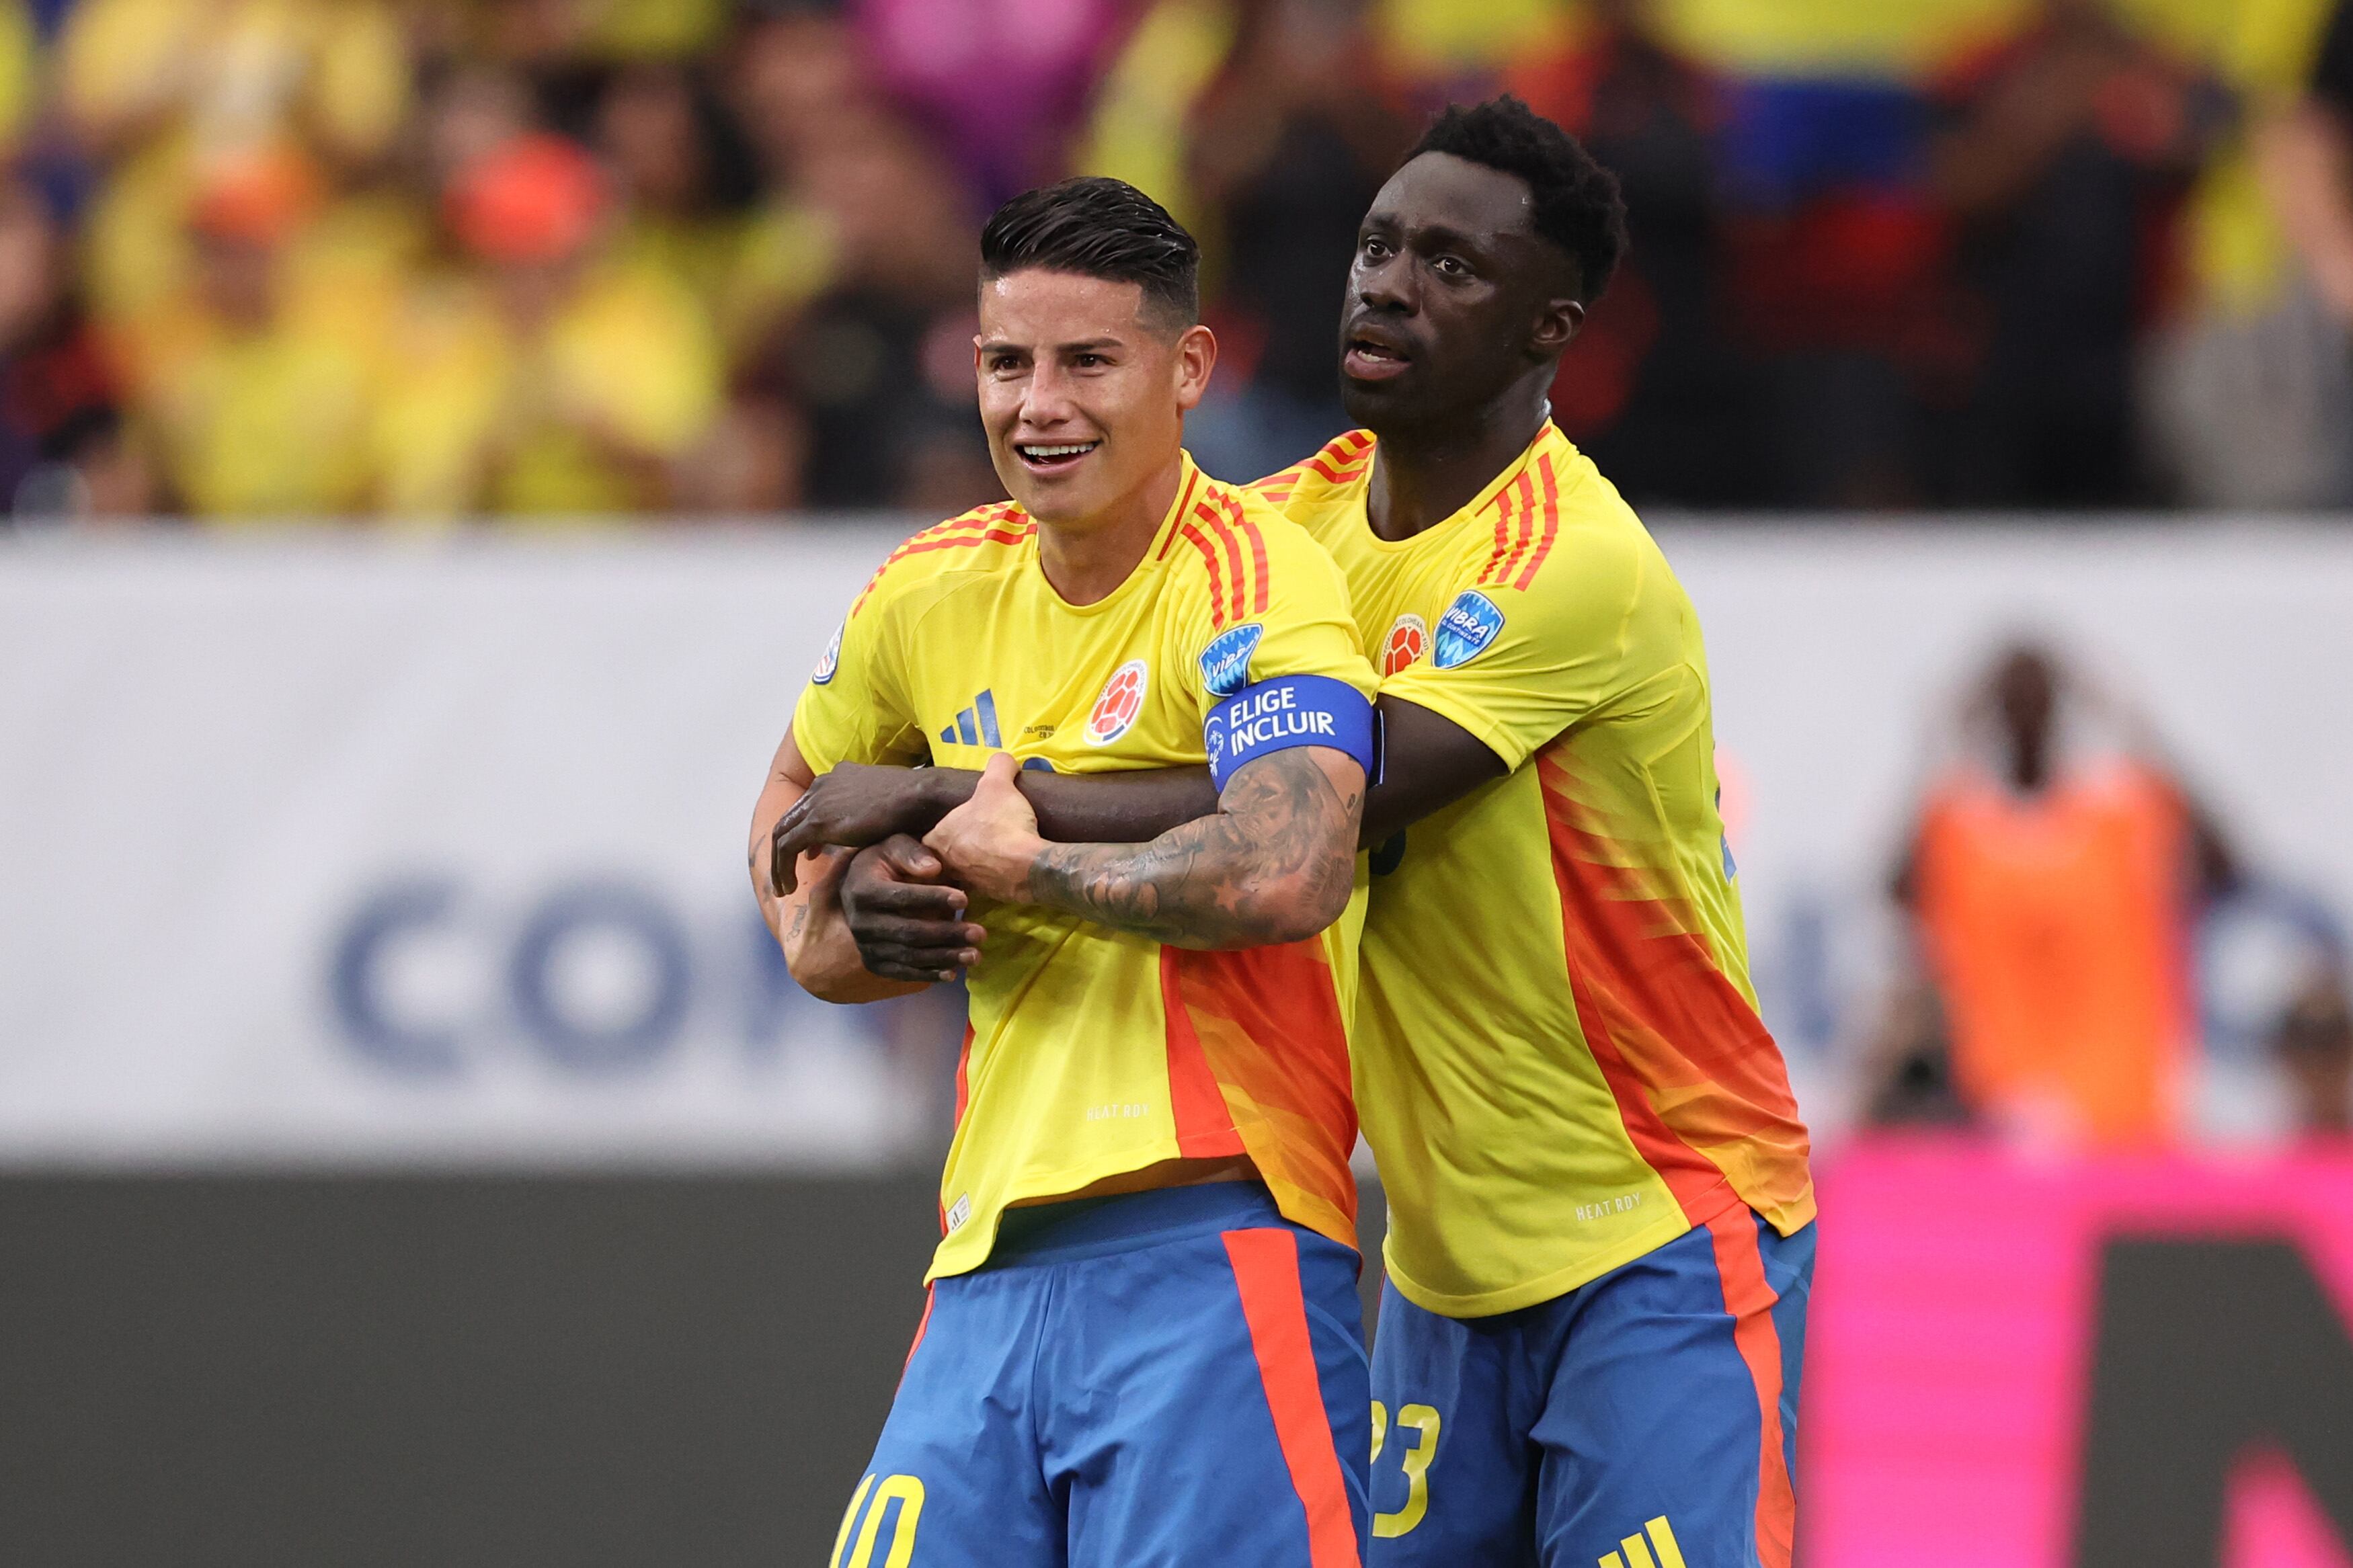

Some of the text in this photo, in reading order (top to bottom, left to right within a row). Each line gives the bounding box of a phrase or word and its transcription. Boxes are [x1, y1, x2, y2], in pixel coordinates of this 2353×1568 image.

[1445, 607, 1489, 639] VIBRA
[1230, 686, 1297, 730] ELIGE
[1230, 711, 1336, 757] INCLUIR
[1086, 1104, 1150, 1122] HEAT RDY
[1575, 1192, 1640, 1221] HEAT RDY
